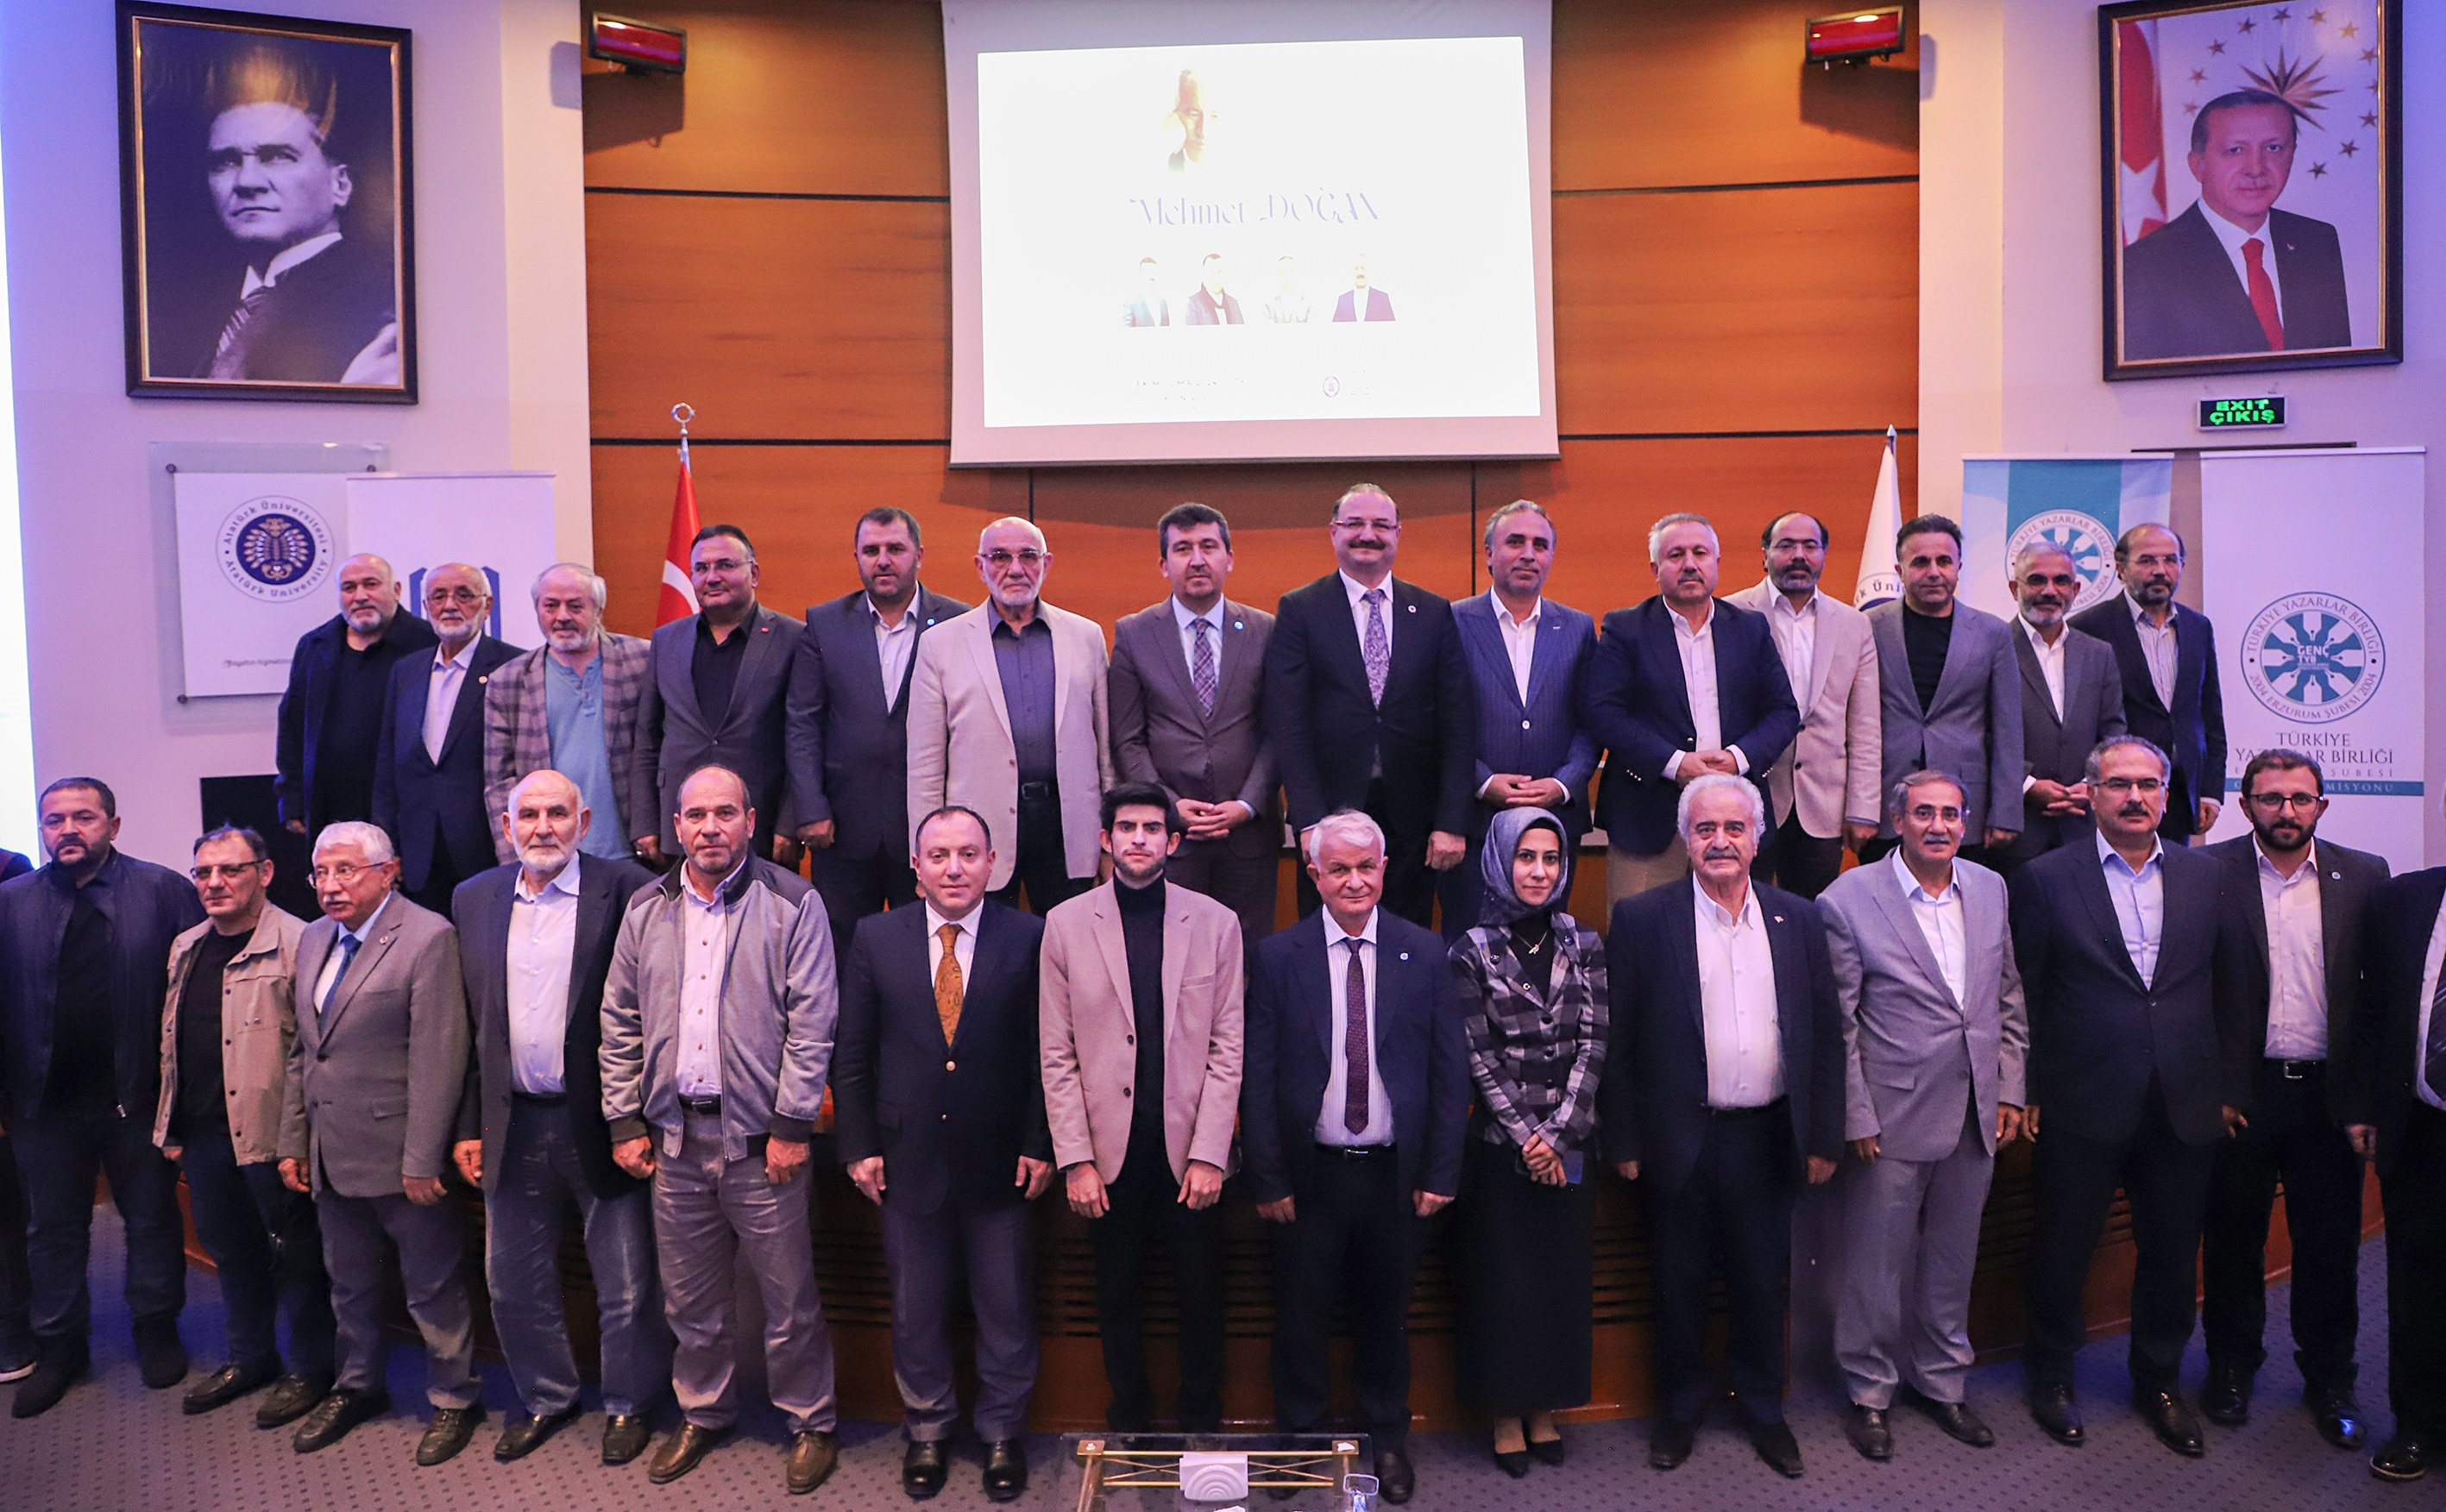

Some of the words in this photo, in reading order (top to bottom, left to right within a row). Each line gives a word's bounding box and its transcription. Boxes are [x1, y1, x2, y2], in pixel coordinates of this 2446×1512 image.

[2216, 398, 2270, 411] EXIT
[2210, 409, 2275, 426] ÇIKIŞ
[223, 505, 257, 545] Atatürk
[261, 500, 328, 544] Üniversitesi
[2039, 515, 2090, 530] YAZARLAR
[225, 560, 264, 594] Atatürk
[270, 559, 328, 597] University
[2281, 596, 2348, 615] YAZARLAR
[2297, 645, 2330, 658] GENÇ
[2249, 674, 2267, 696] 2004
[2266, 696, 2321, 718] ERZURUM
[2357, 673, 2377, 696] 2004
[2275, 731, 2351, 747] TÜRKİYE
[2331, 748, 2393, 764] BİRLİĞİ
